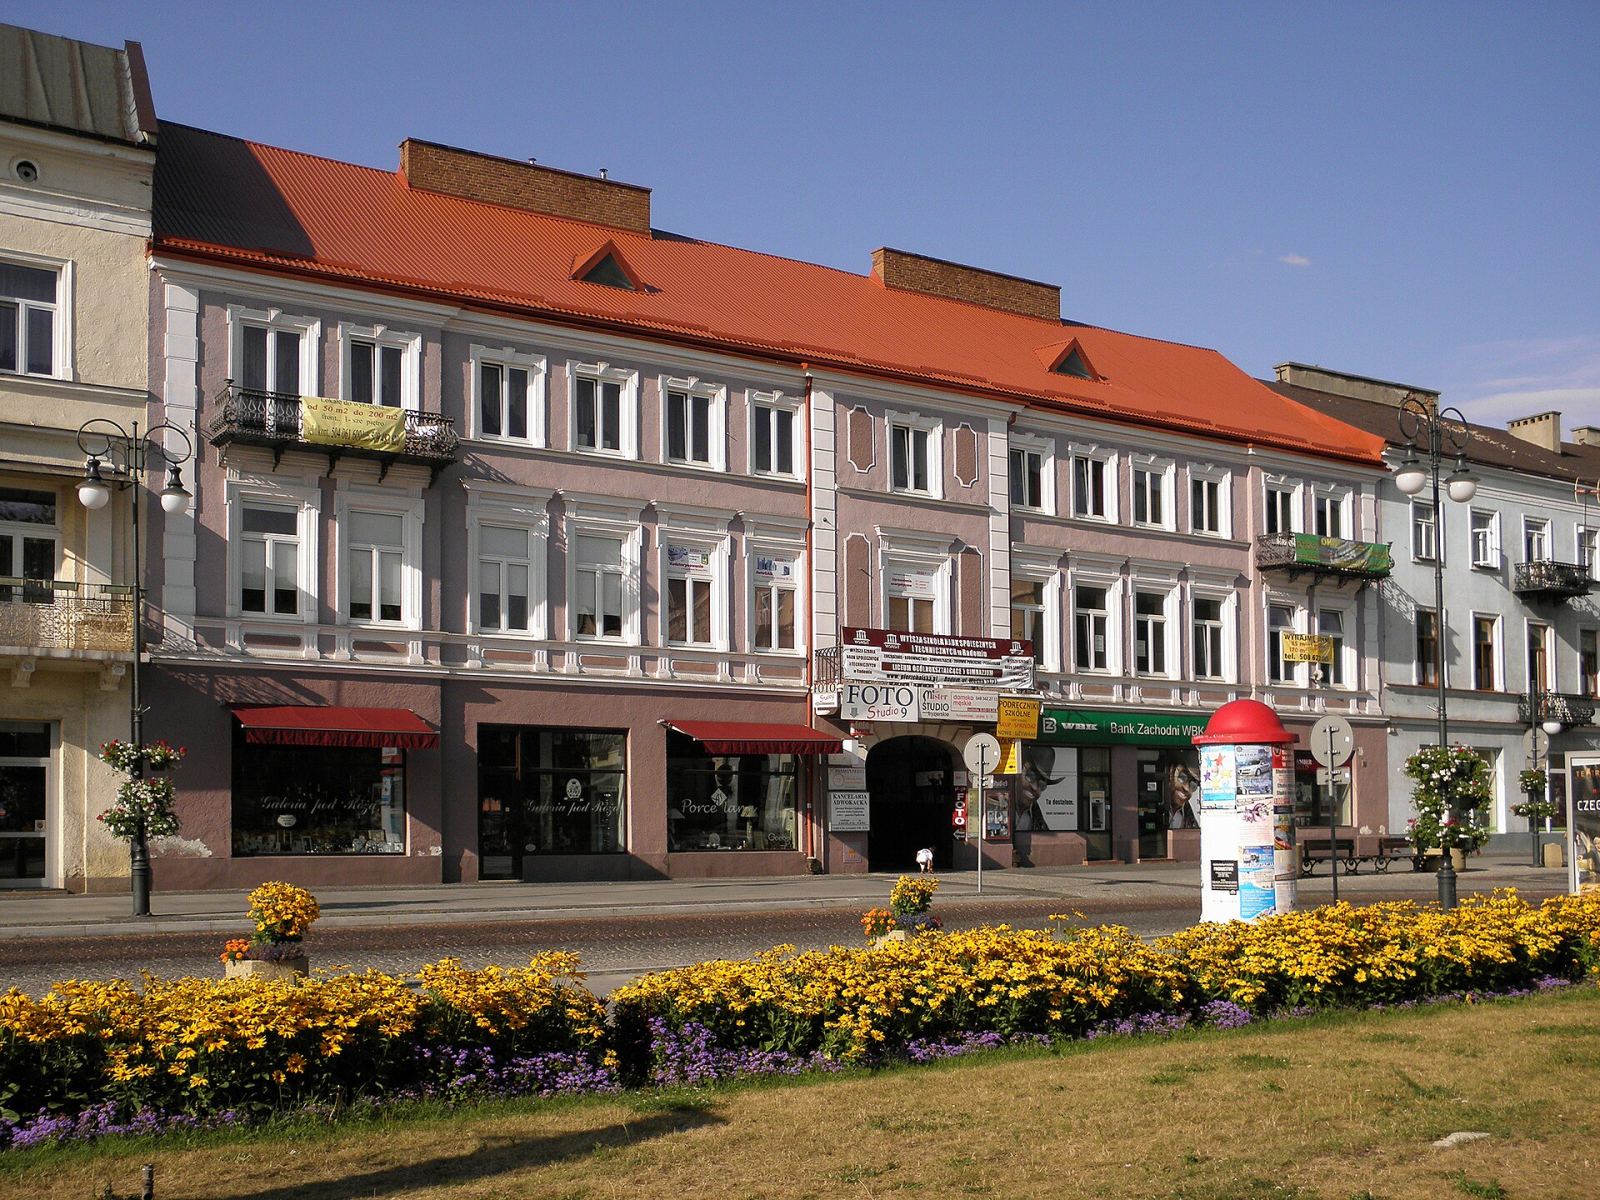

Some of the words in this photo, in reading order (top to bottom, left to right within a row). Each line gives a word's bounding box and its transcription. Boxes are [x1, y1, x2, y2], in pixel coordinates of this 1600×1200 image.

[846, 684, 913, 706] FOTO
[867, 705, 899, 719] Studio
[901, 707, 907, 718] 9
[922, 702, 949, 711] STUDIO
[1061, 722, 1098, 731] WBK
[1110, 722, 1135, 734] Bank
[1137, 723, 1180, 736] Zachodni
[1182, 725, 1204, 736] WBK
[262, 796, 307, 809] Galeria
[310, 799, 337, 814] pod
[567, 802, 590, 816] pod
[954, 793, 966, 825] FOTO
